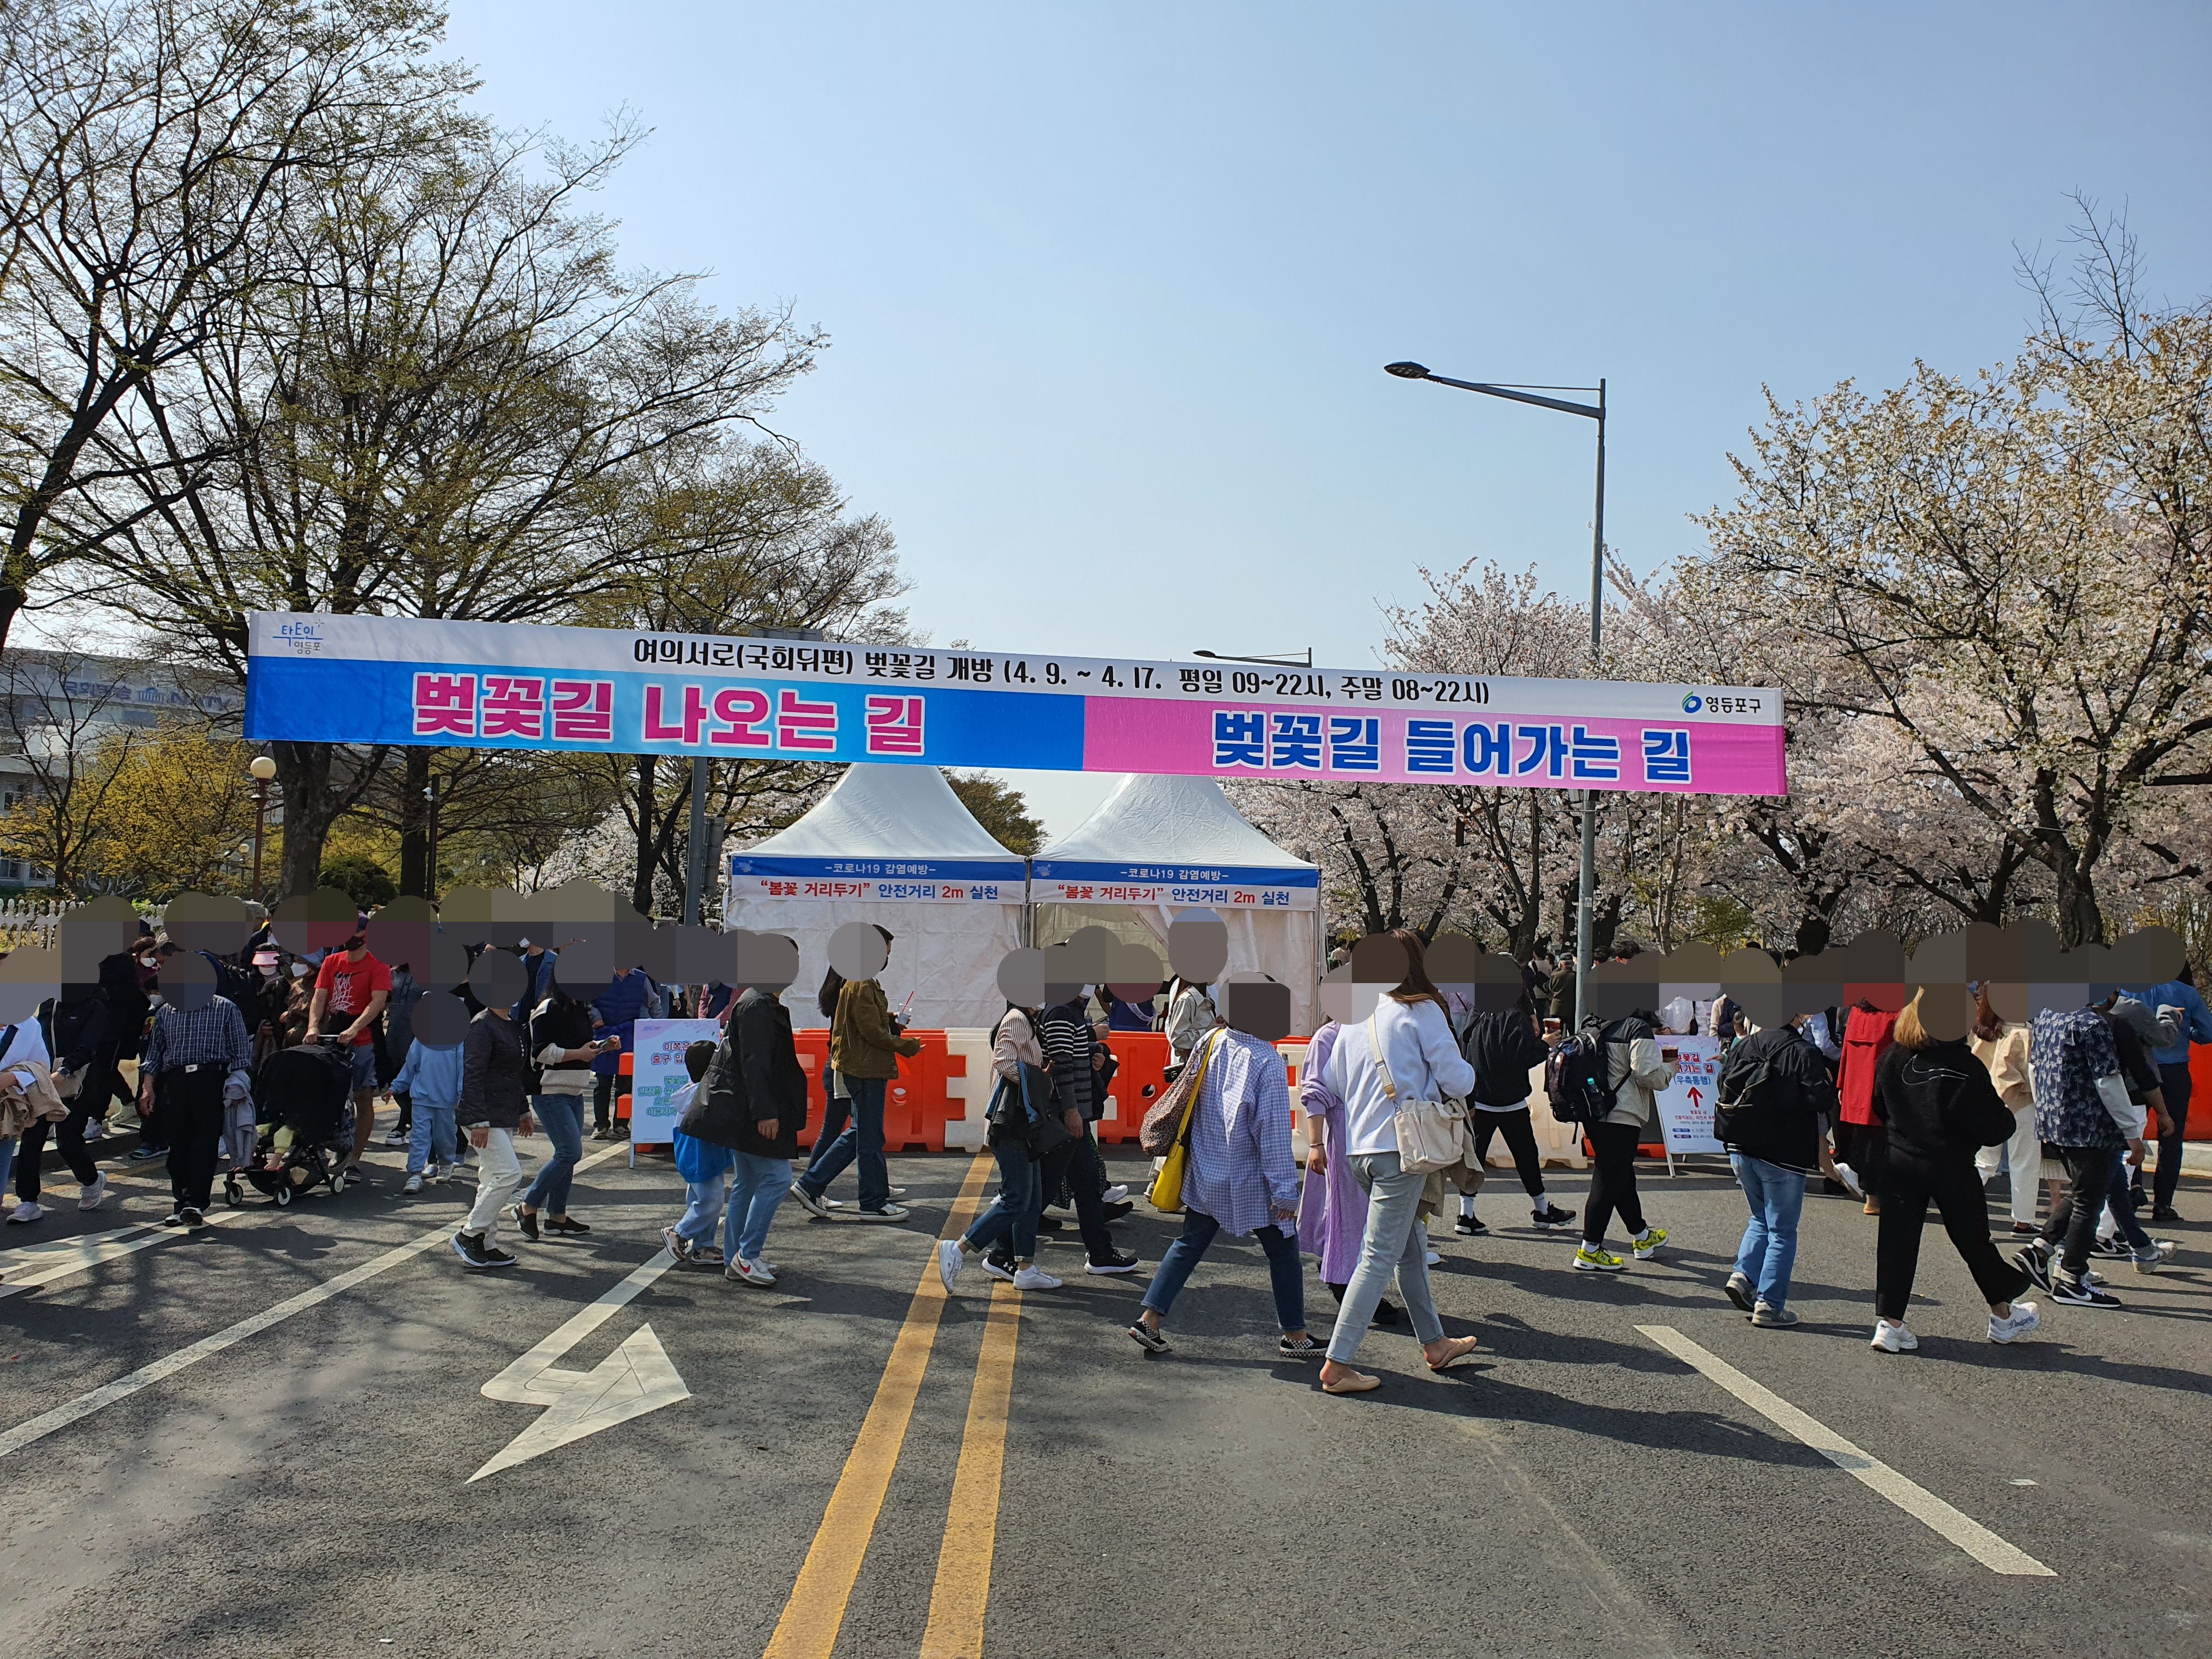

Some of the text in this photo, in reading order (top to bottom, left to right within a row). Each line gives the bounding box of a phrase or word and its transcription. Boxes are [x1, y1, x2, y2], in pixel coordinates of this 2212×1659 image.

[294, 641, 321, 655] 영등포
[634, 637, 853, 674] 여의서로(국회뒤편)
[865, 651, 935, 680] 벚꽃길
[947, 656, 994, 683] 개방
[1004, 661, 1036, 684] (4.
[1045, 662, 1066, 685] 9.
[1101, 665, 1124, 689] 4.
[1134, 667, 1161, 690] 17.
[1180, 668, 1222, 694] 평일
[1232, 670, 1331, 699] 09~22시,
[1340, 675, 1383, 701] 주말
[1392, 678, 1489, 705] 08~22시)
[1705, 695, 1762, 714] 영등포구
[414, 673, 925, 756] 벚꽃길 나오는 길
[1212, 710, 1691, 784] 벚꽃길 들어가는 길
[878, 884, 935, 899] 안전거리
[942, 886, 963, 899] 2m
[970, 885, 998, 900] 실천
[1172, 888, 1228, 904] 안전거리
[1234, 890, 1255, 904] 2m
[1262, 891, 1289, 906] 실천
[651, 1053, 670, 1064] 출구
[1703, 1063, 1714, 1074] 길
[1674, 1075, 1711, 1085] (우측통행)
